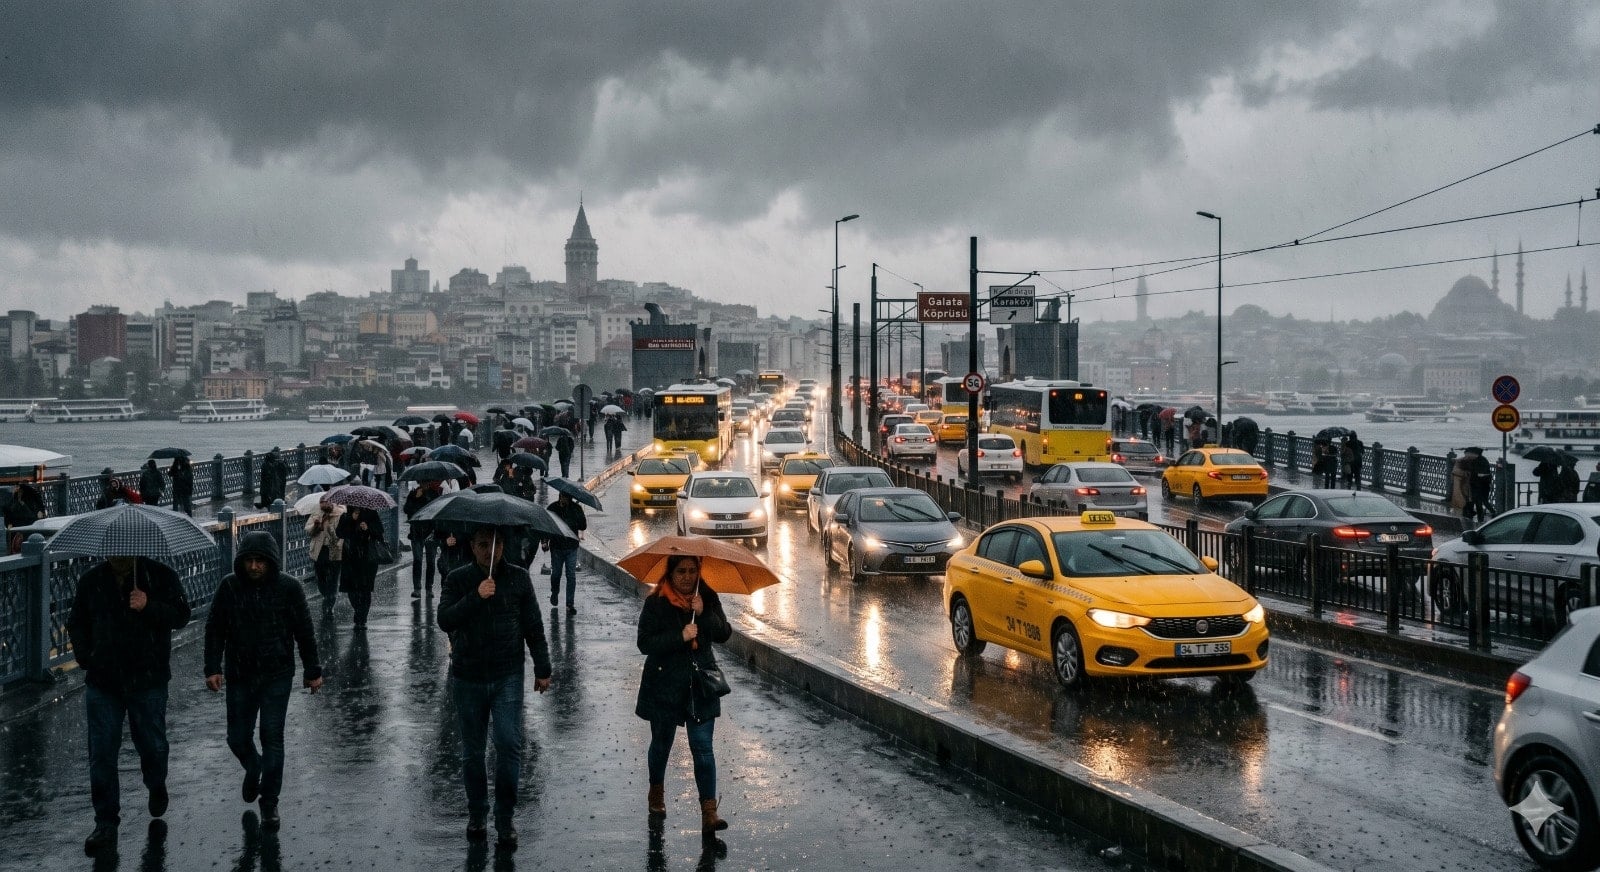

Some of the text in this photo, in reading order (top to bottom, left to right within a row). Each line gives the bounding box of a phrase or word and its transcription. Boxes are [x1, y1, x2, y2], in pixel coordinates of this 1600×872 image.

[928, 297, 963, 306] Galata
[993, 297, 1031, 307] Karaköy
[923, 308, 968, 319] Köprüsü
[1006, 615, 1016, 632] 34
[1181, 645, 1193, 655] 34
[1196, 644, 1209, 653] TT
